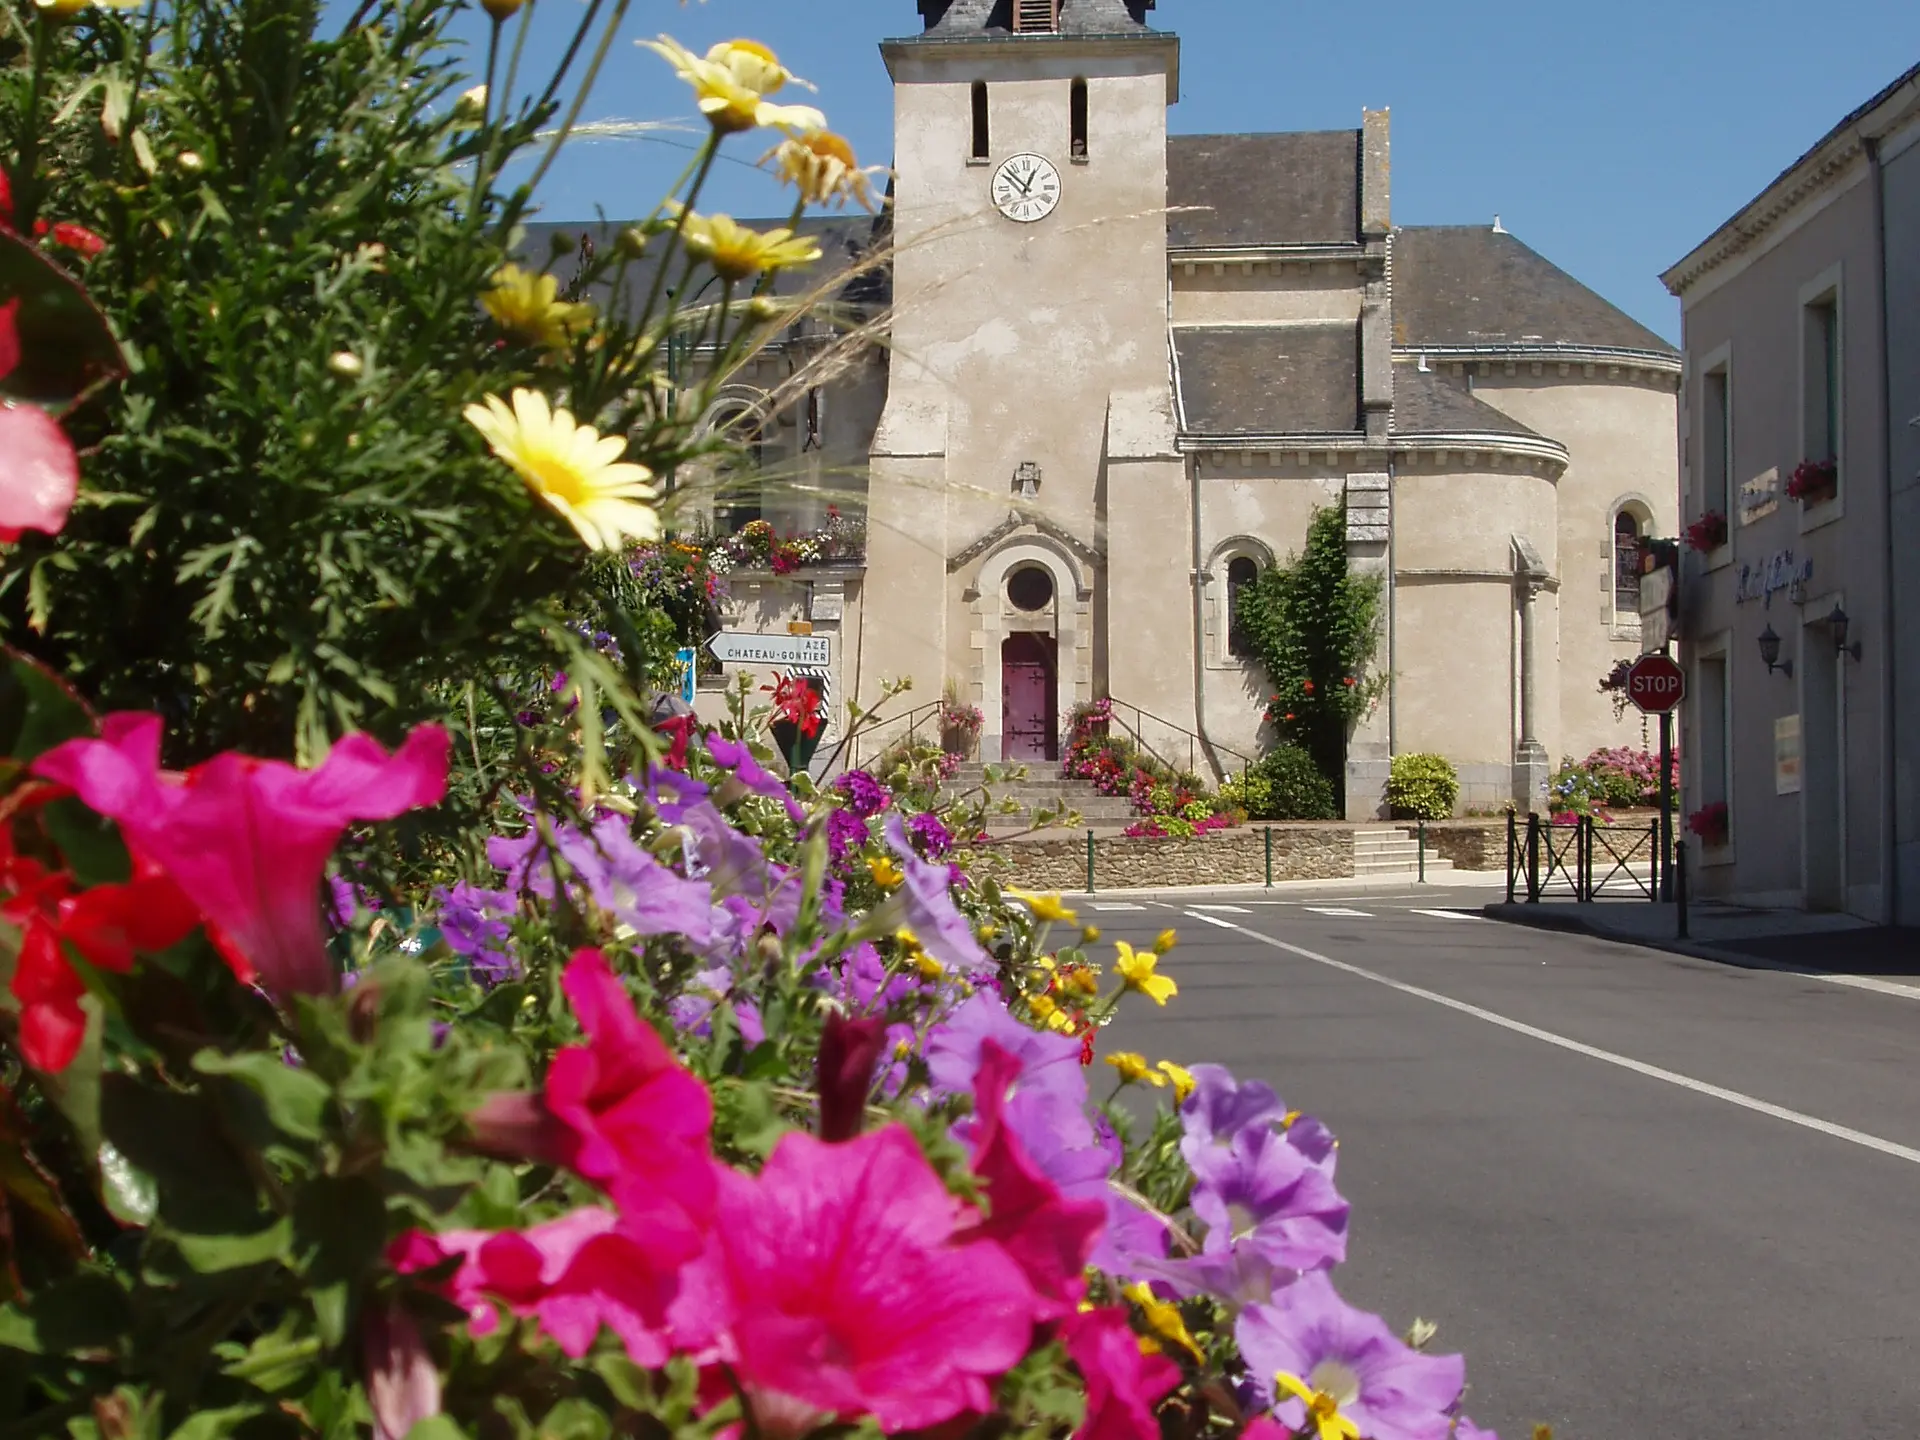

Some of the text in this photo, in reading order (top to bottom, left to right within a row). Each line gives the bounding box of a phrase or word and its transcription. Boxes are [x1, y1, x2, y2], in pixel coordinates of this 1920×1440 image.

[805, 640, 827, 650] AZÉ
[727, 649, 827, 661] CHATEAU-GONTIER
[1633, 676, 1678, 692] STOP
